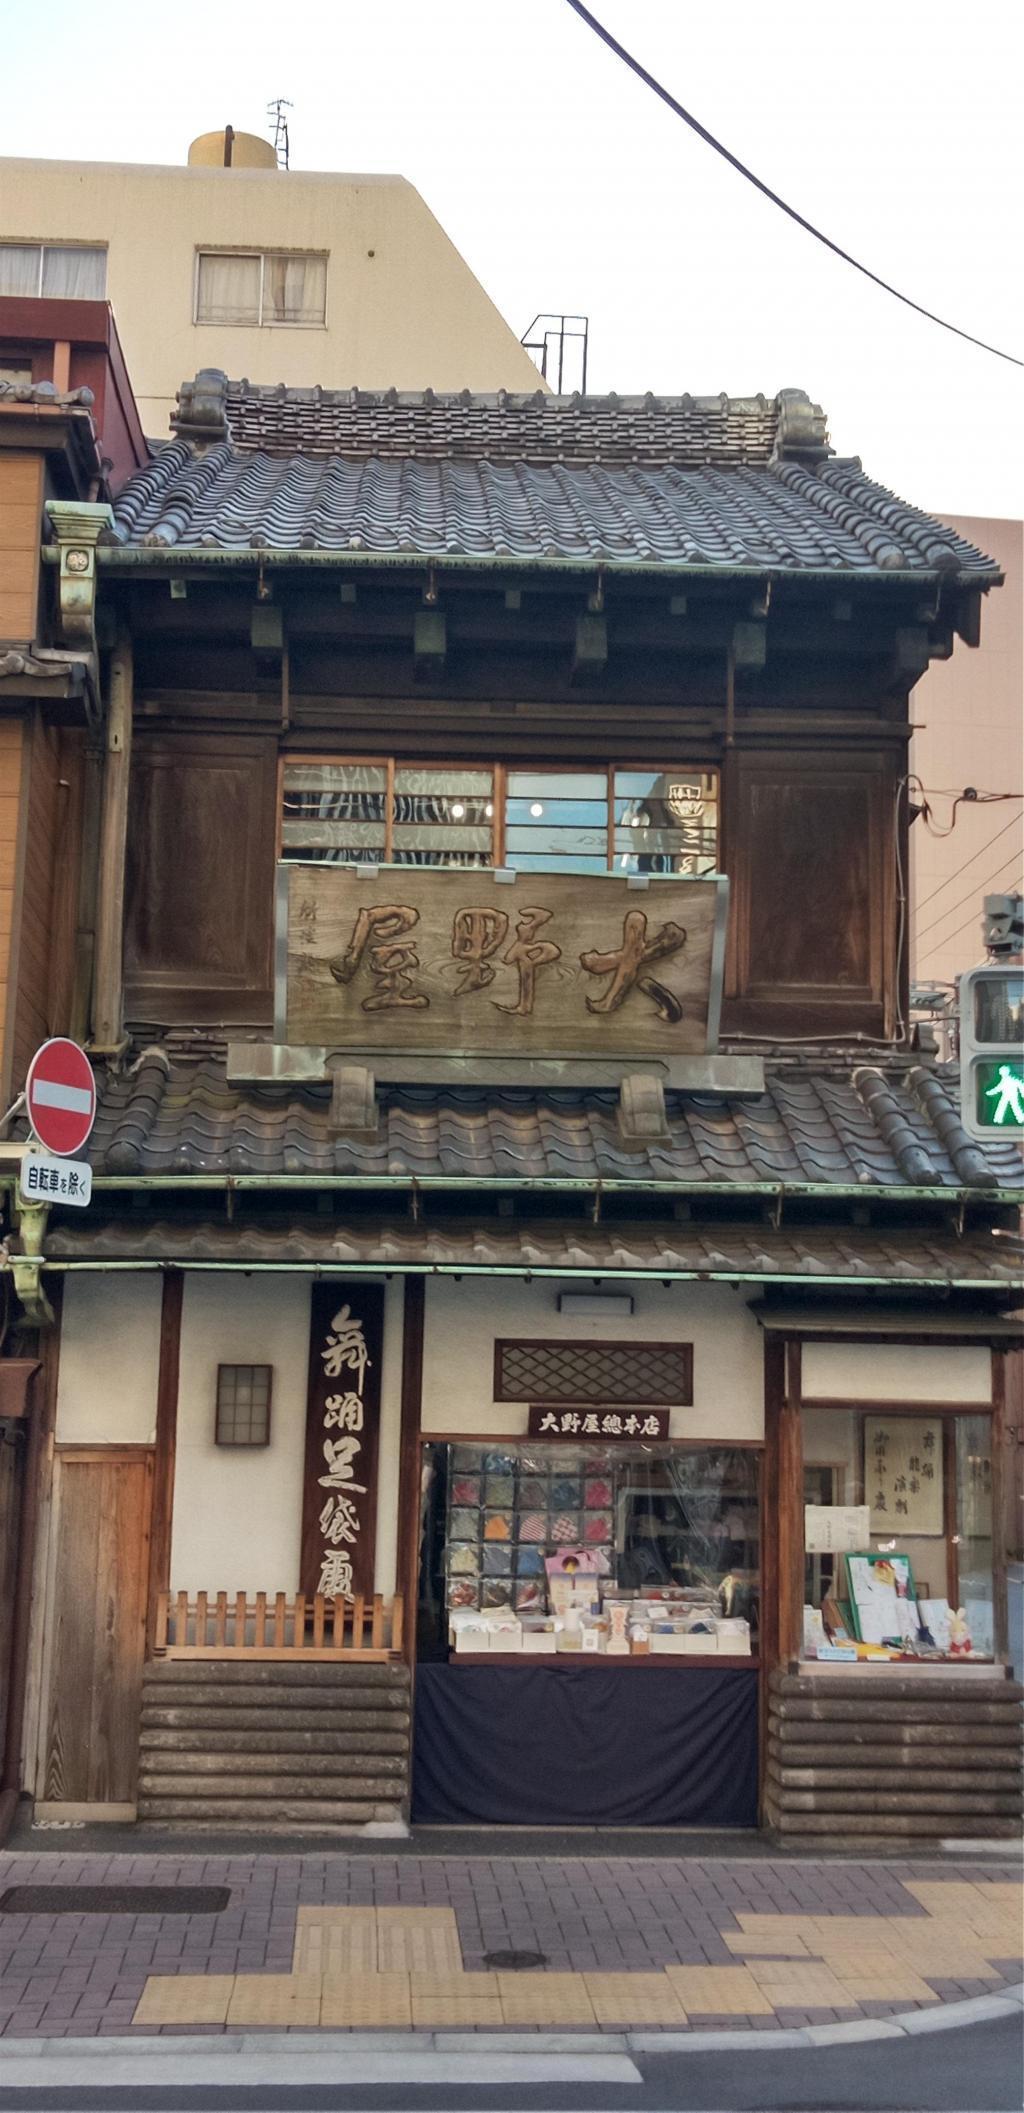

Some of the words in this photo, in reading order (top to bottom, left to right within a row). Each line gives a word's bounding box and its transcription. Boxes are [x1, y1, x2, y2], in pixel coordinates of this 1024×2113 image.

[28, 1165, 86, 1197] 自転車を除く
[538, 1412, 660, 1436] 大野屋總本店
